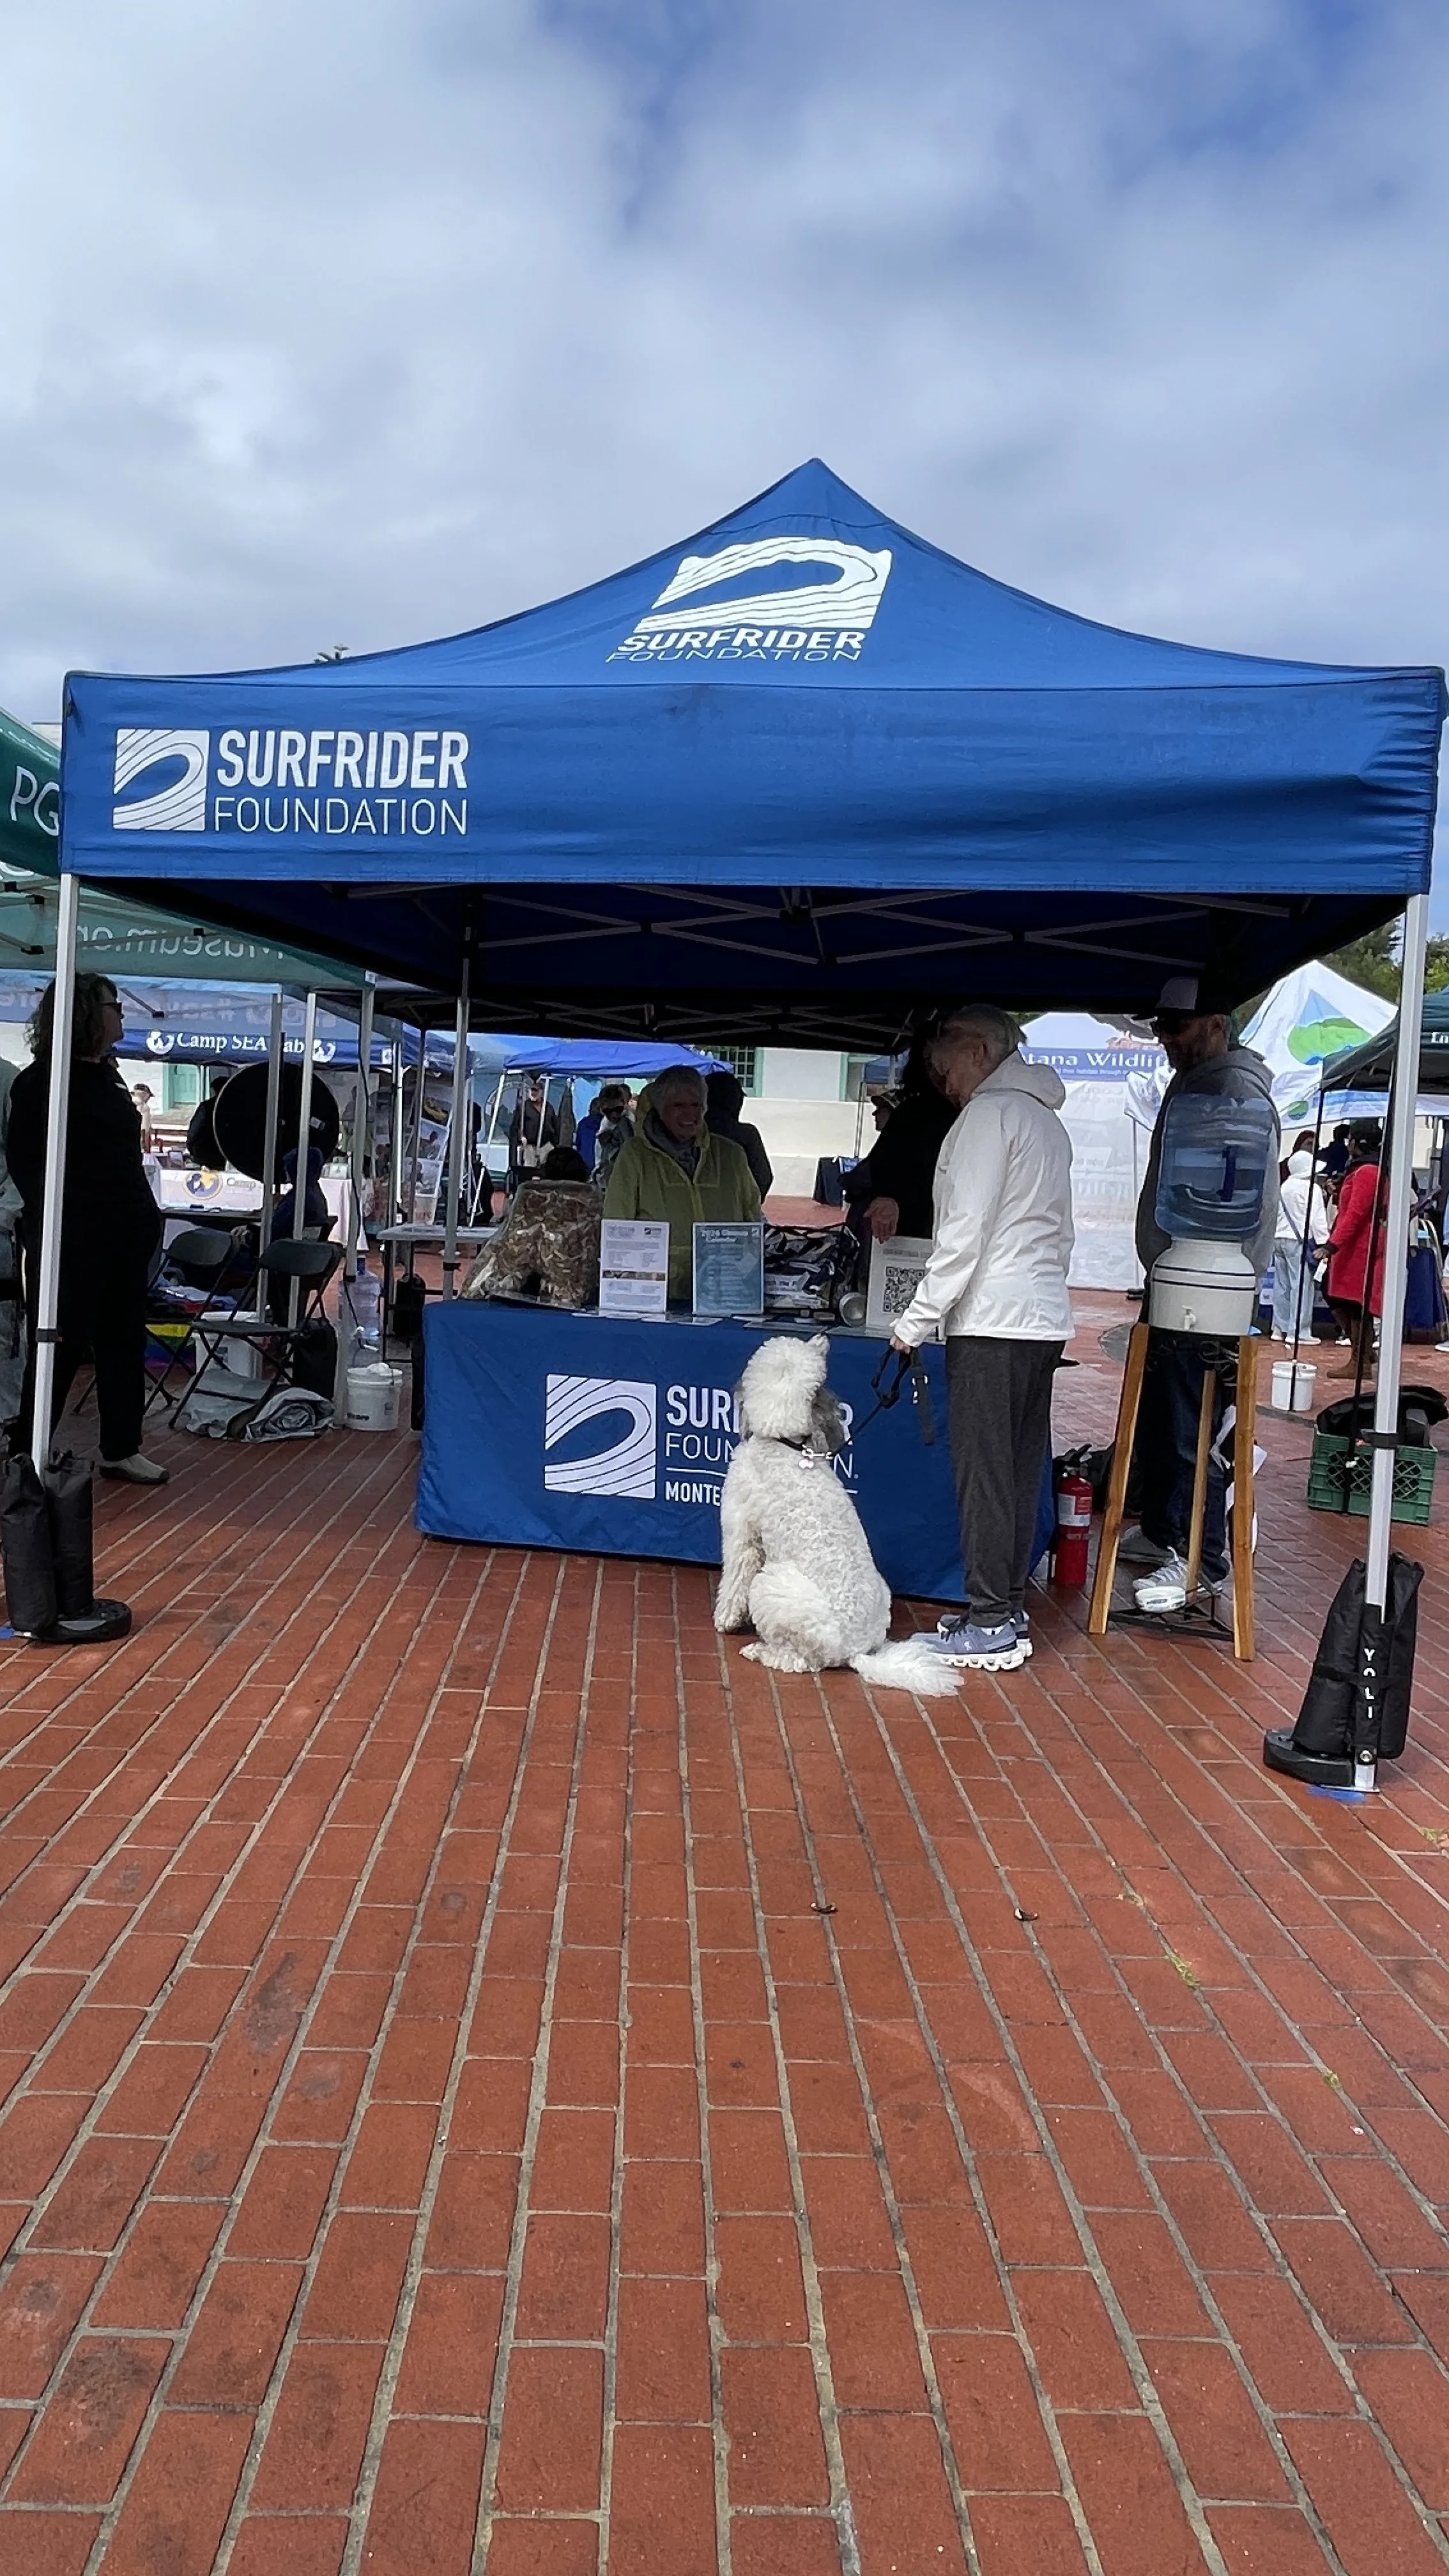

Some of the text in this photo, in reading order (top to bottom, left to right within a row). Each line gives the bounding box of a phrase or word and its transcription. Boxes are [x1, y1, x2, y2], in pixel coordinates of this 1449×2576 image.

[617, 627, 866, 652] SURFRIDER
[604, 647, 862, 663] FOUNDATION
[217, 730, 470, 788] SURFRIDER
[214, 796, 468, 835] FOUNDATION
[176, 1033, 305, 1054] Camp SEA ab
